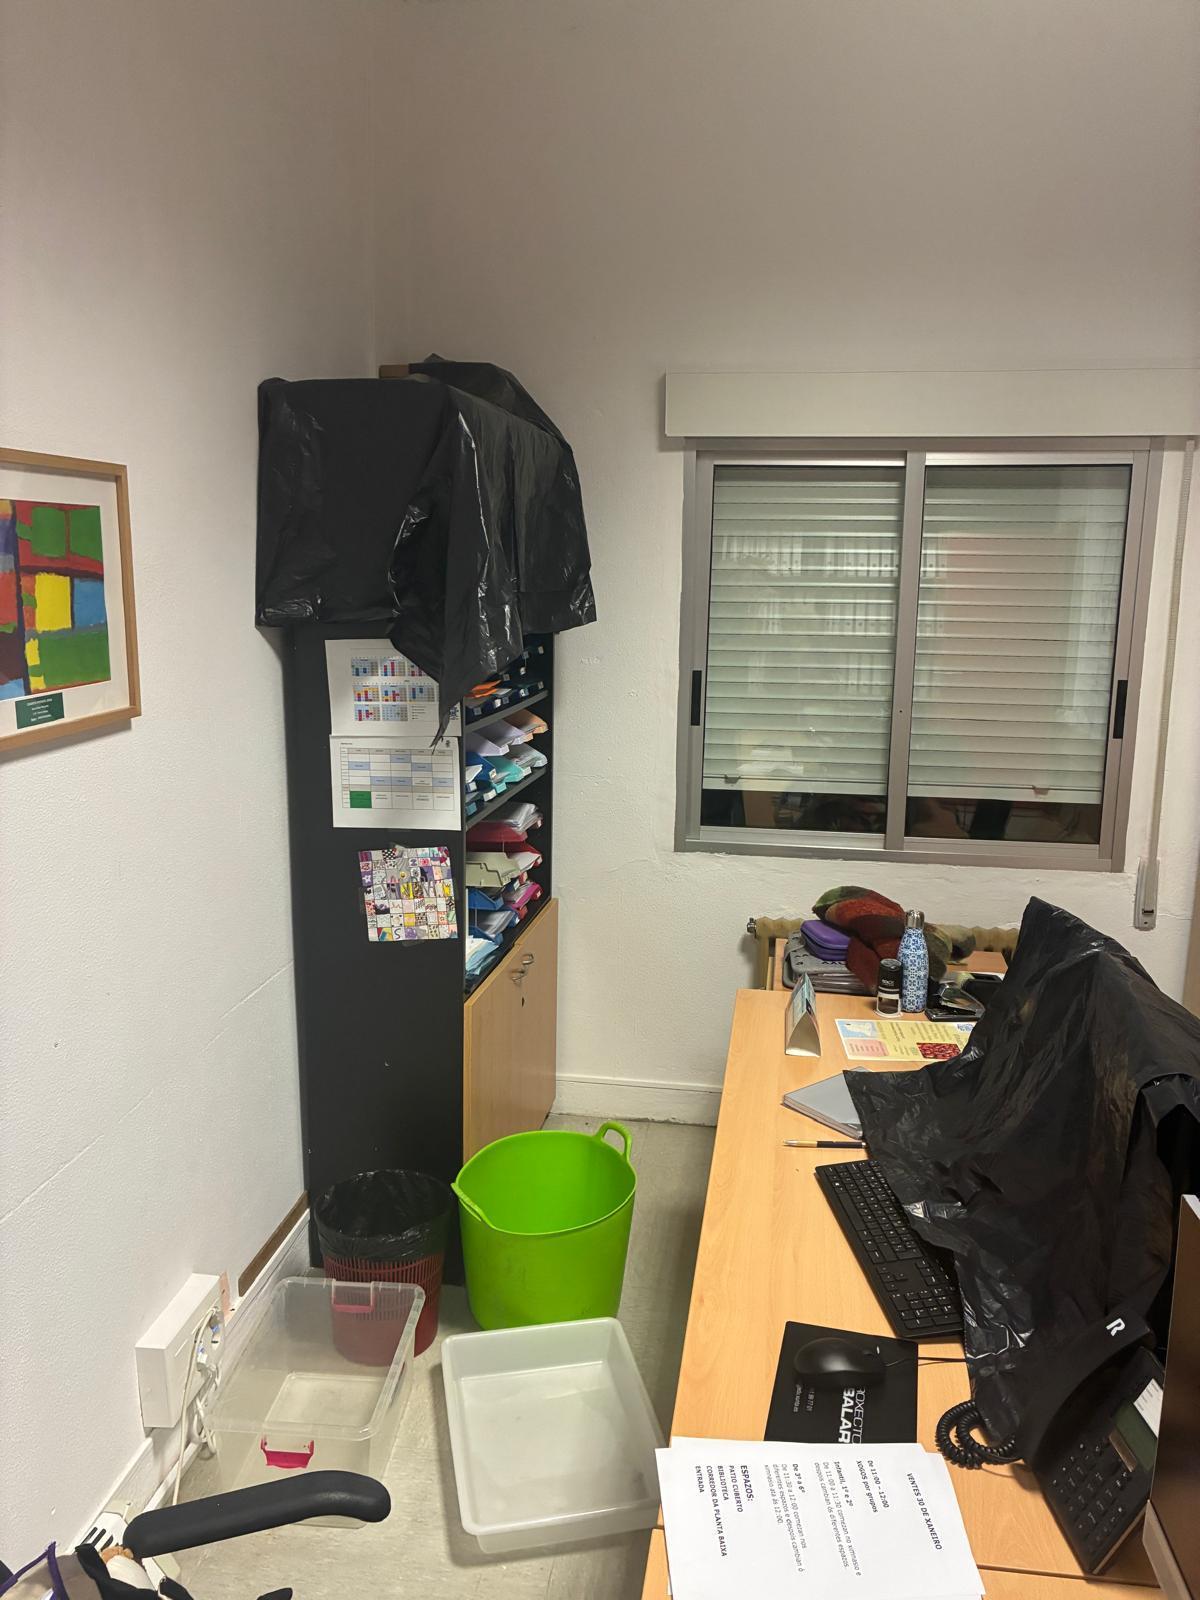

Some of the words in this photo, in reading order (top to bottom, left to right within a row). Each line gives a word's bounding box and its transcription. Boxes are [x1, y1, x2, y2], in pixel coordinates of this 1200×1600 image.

[851, 1387, 865, 1444] OXECTO
[696, 1466, 704, 1493] ENTRADA
[706, 1466, 717, 1497] CORREDOR
[718, 1466, 728, 1500] BIBLIOTECA
[729, 1466, 737, 1483] PATIO
[741, 1466, 754, 1501] ESPAZOS:
[856, 1460, 867, 1479] XOGOS
[862, 1482, 870, 1490] por
[866, 1493, 878, 1512] grupos
[871, 1469, 880, 1484] 11:00
[879, 1492, 889, 1507] 12:00
[712, 1499, 718, 1507] DA
[732, 1484, 743, 1512] CUBERTO
[907, 1473, 921, 1496] VENTES
[917, 1498, 925, 1506] 30
[921, 1508, 929, 1516] DE
[925, 1518, 942, 1550] XANEIRO
[714, 1509, 723, 1534] PLANTA
[718, 1536, 727, 1556] BAIXA
